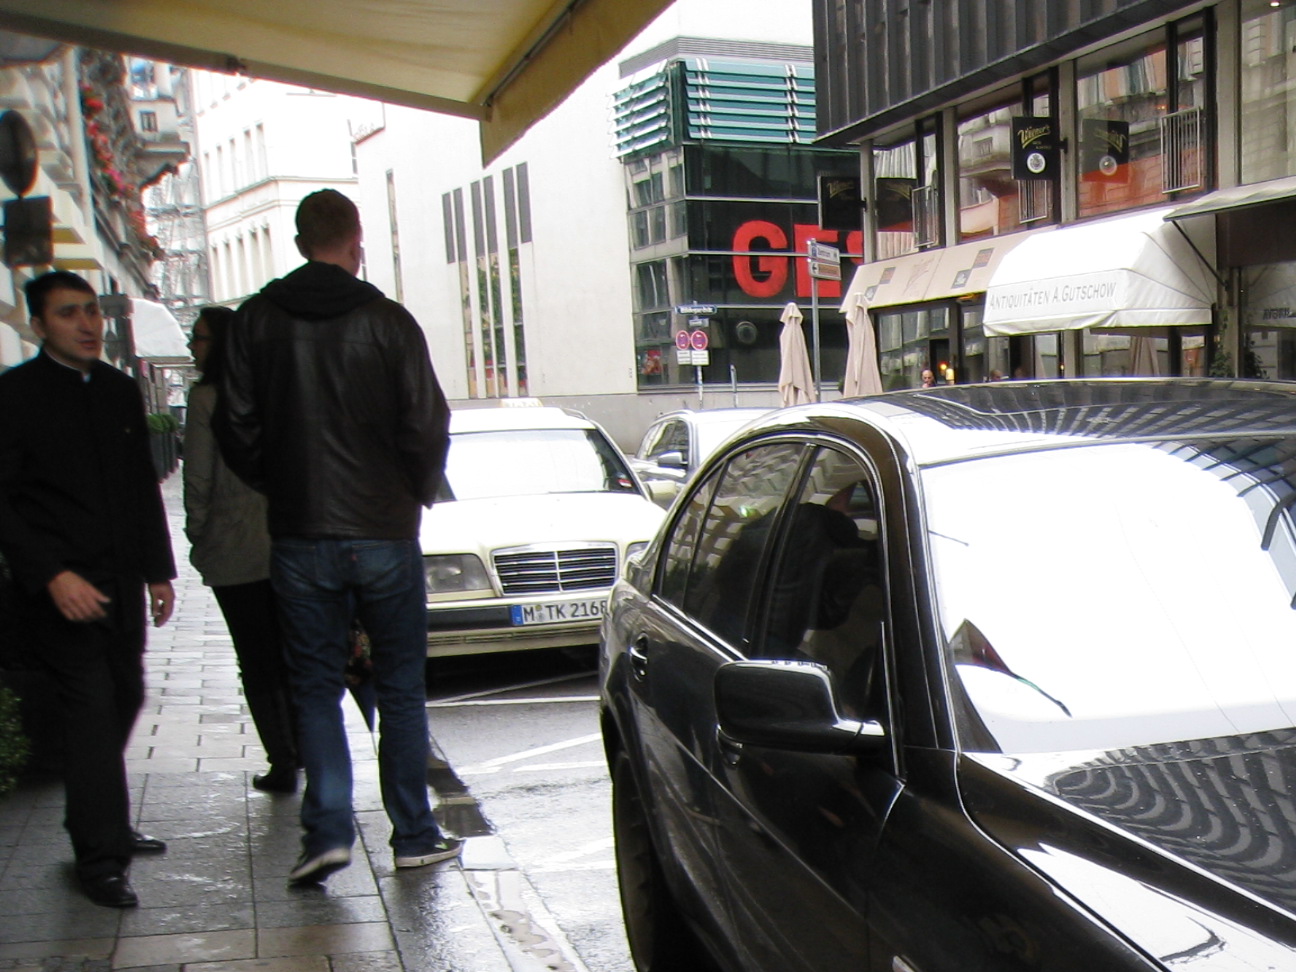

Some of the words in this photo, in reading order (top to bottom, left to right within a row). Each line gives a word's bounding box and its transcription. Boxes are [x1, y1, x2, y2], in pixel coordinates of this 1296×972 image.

[990, 288, 1049, 309] ANTIQUITÄTEN
[523, 606, 535, 622] M
[544, 604, 566, 620] TK
